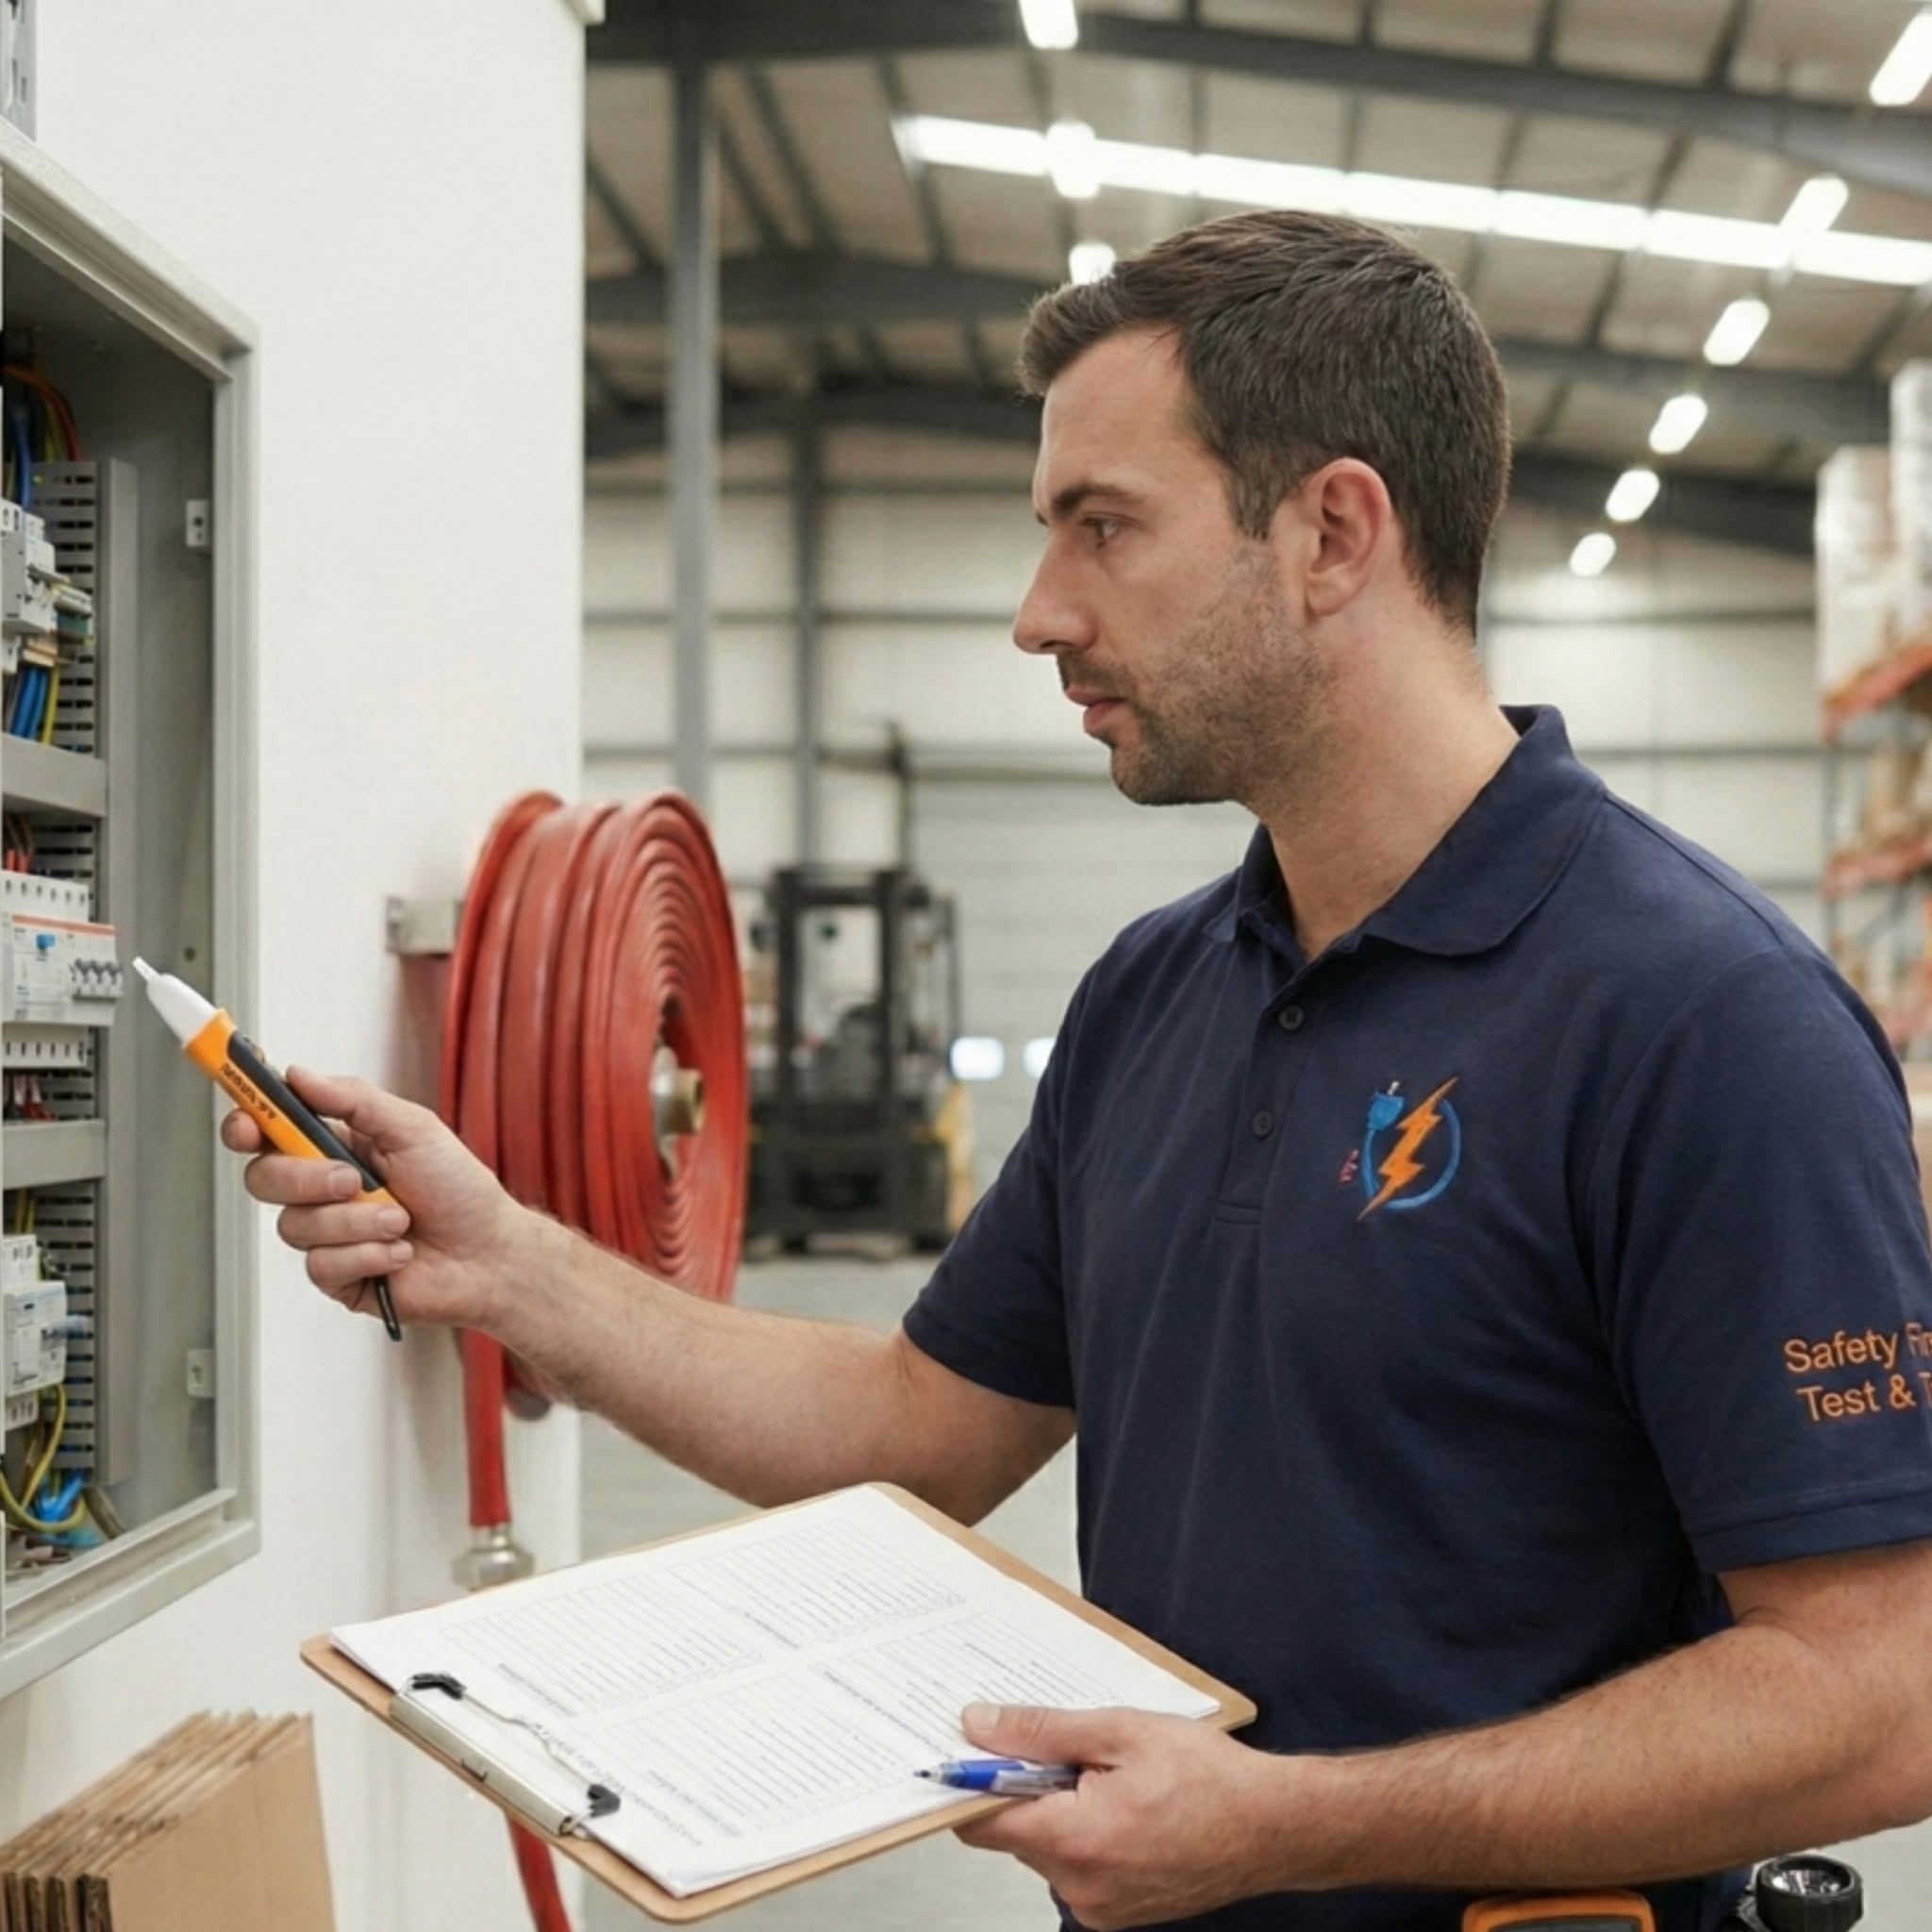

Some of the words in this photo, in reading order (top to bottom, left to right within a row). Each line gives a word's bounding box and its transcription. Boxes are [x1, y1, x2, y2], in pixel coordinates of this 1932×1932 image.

[1784, 1328, 1898, 1374] Safety
[1796, 1380, 1882, 1422] Test
[1890, 1374, 1917, 1409] &
